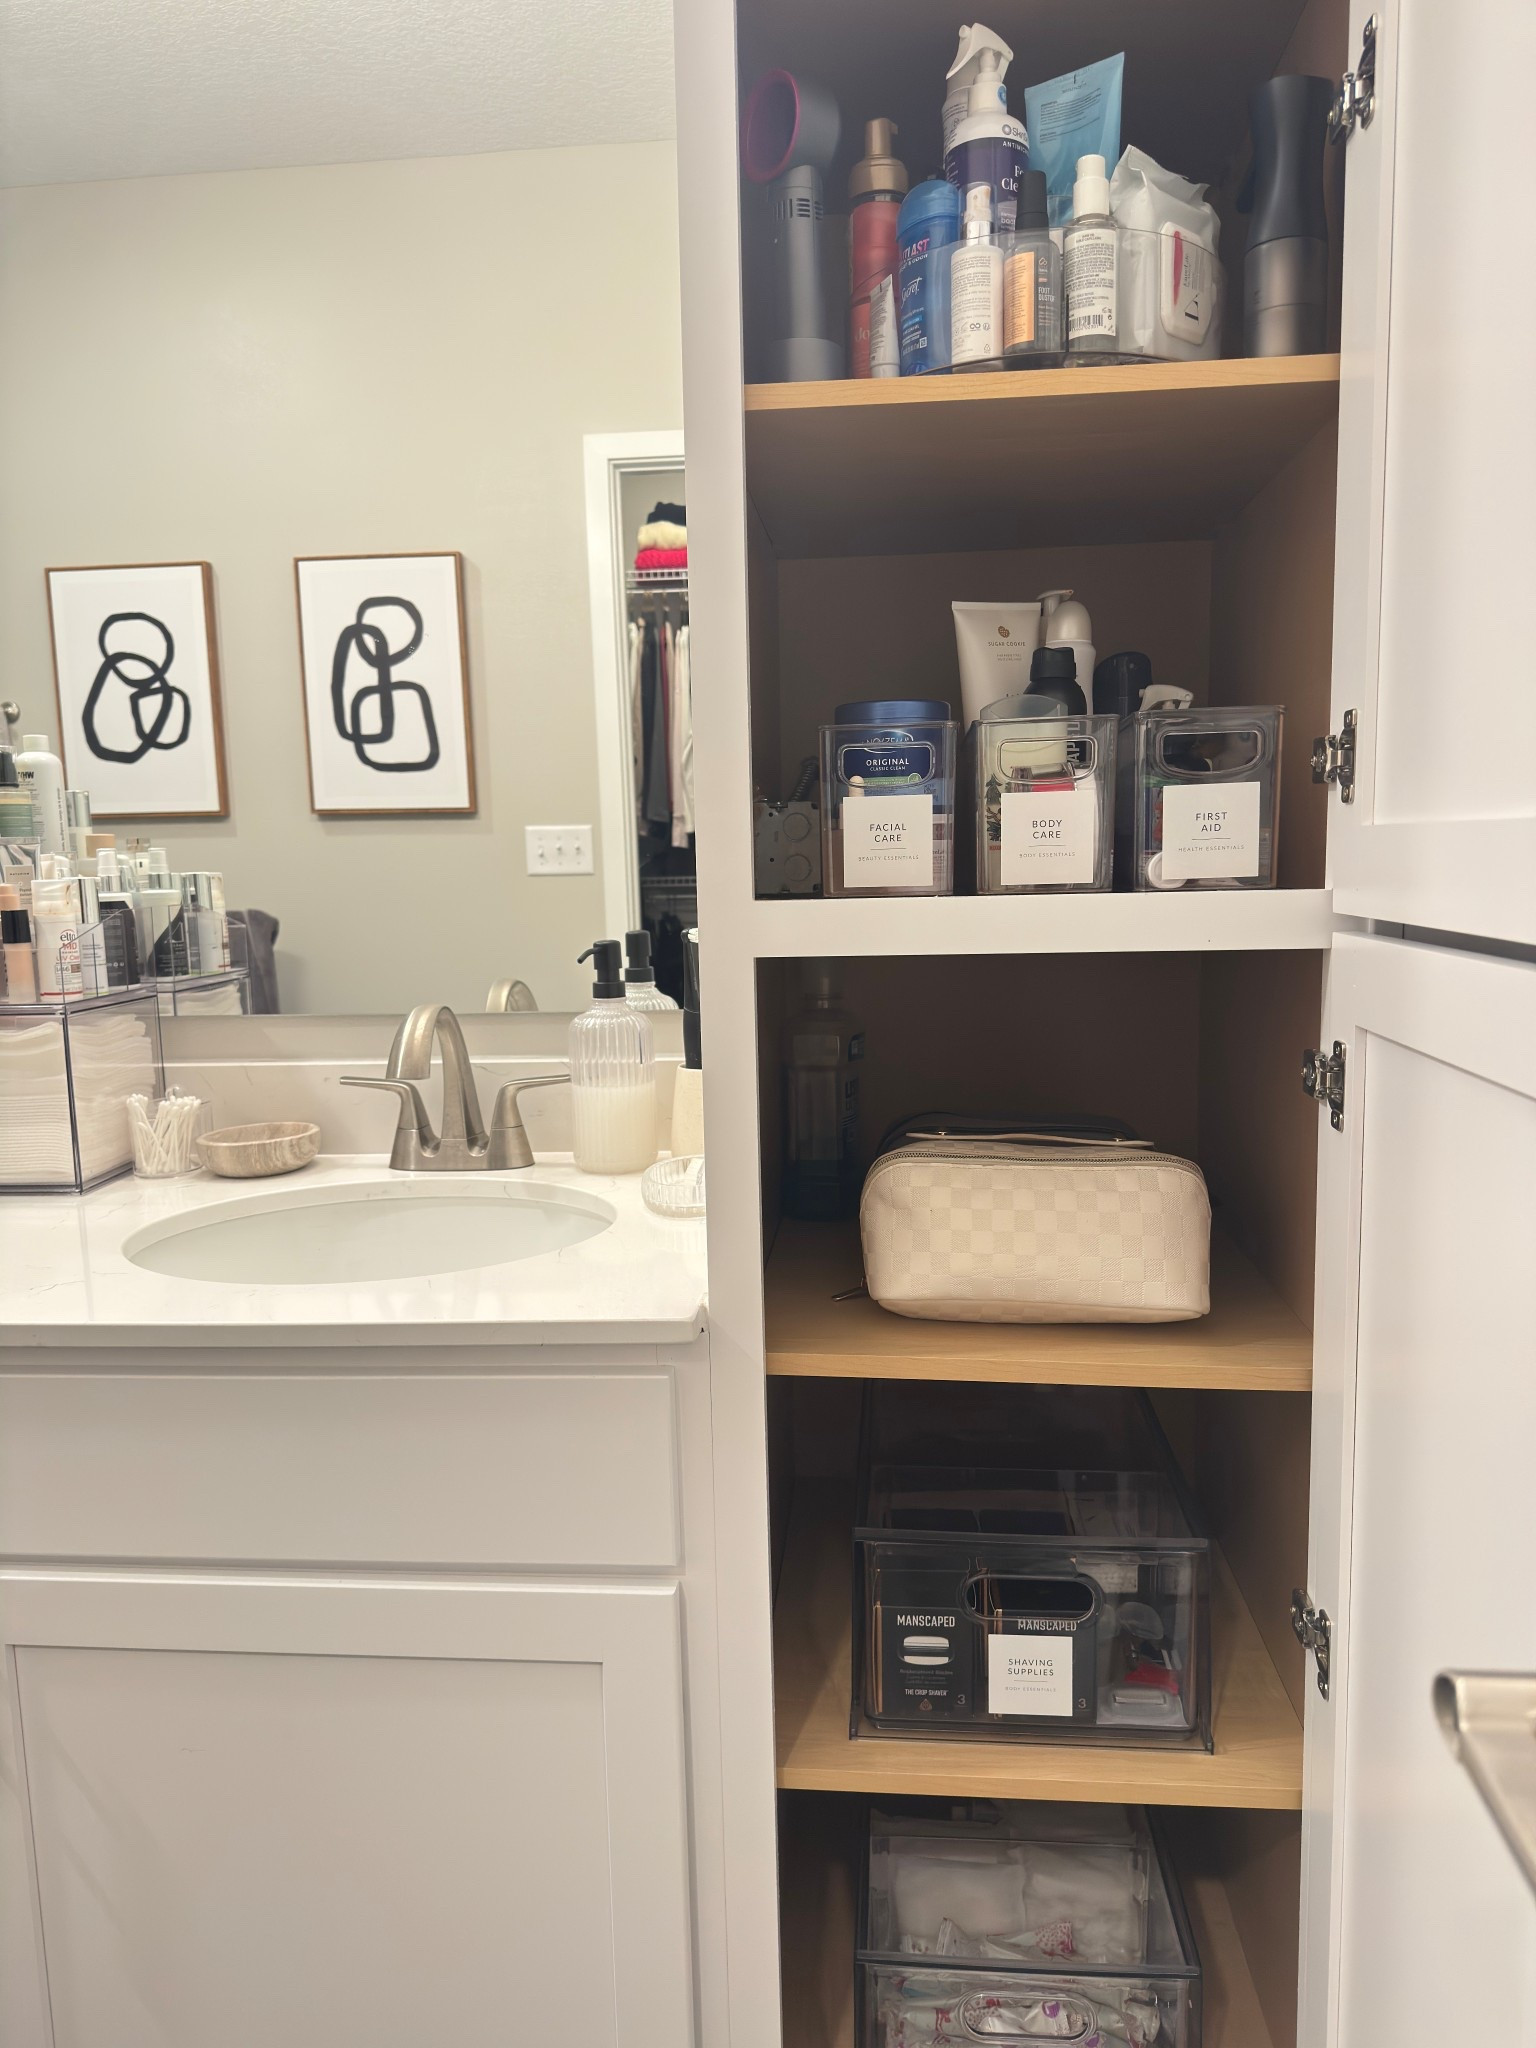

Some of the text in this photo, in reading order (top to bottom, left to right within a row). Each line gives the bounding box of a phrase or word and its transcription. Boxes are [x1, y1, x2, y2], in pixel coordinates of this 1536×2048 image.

[901, 277, 922, 309] Secret
[1038, 286, 1050, 294] FOOT
[865, 758, 910, 767] ORIGINAL
[1195, 811, 1228, 821] FIRST
[869, 823, 907, 832] FACIAL
[1032, 819, 1063, 828] BODY
[1201, 823, 1222, 832] AID
[874, 834, 902, 843] CARE
[1032, 830, 1062, 839] CARE
[897, 1614, 956, 1628] MANSCAPED
[1017, 1619, 1077, 1632] MANSCAPED
[1008, 1658, 1054, 1667] SHAVING
[1007, 1667, 1055, 1677] SUPPLIES
[904, 1688, 914, 1696] THE
[915, 1688, 928, 1696] CROP
[957, 1694, 966, 1705] 3
[1078, 1698, 1087, 1709] 3
